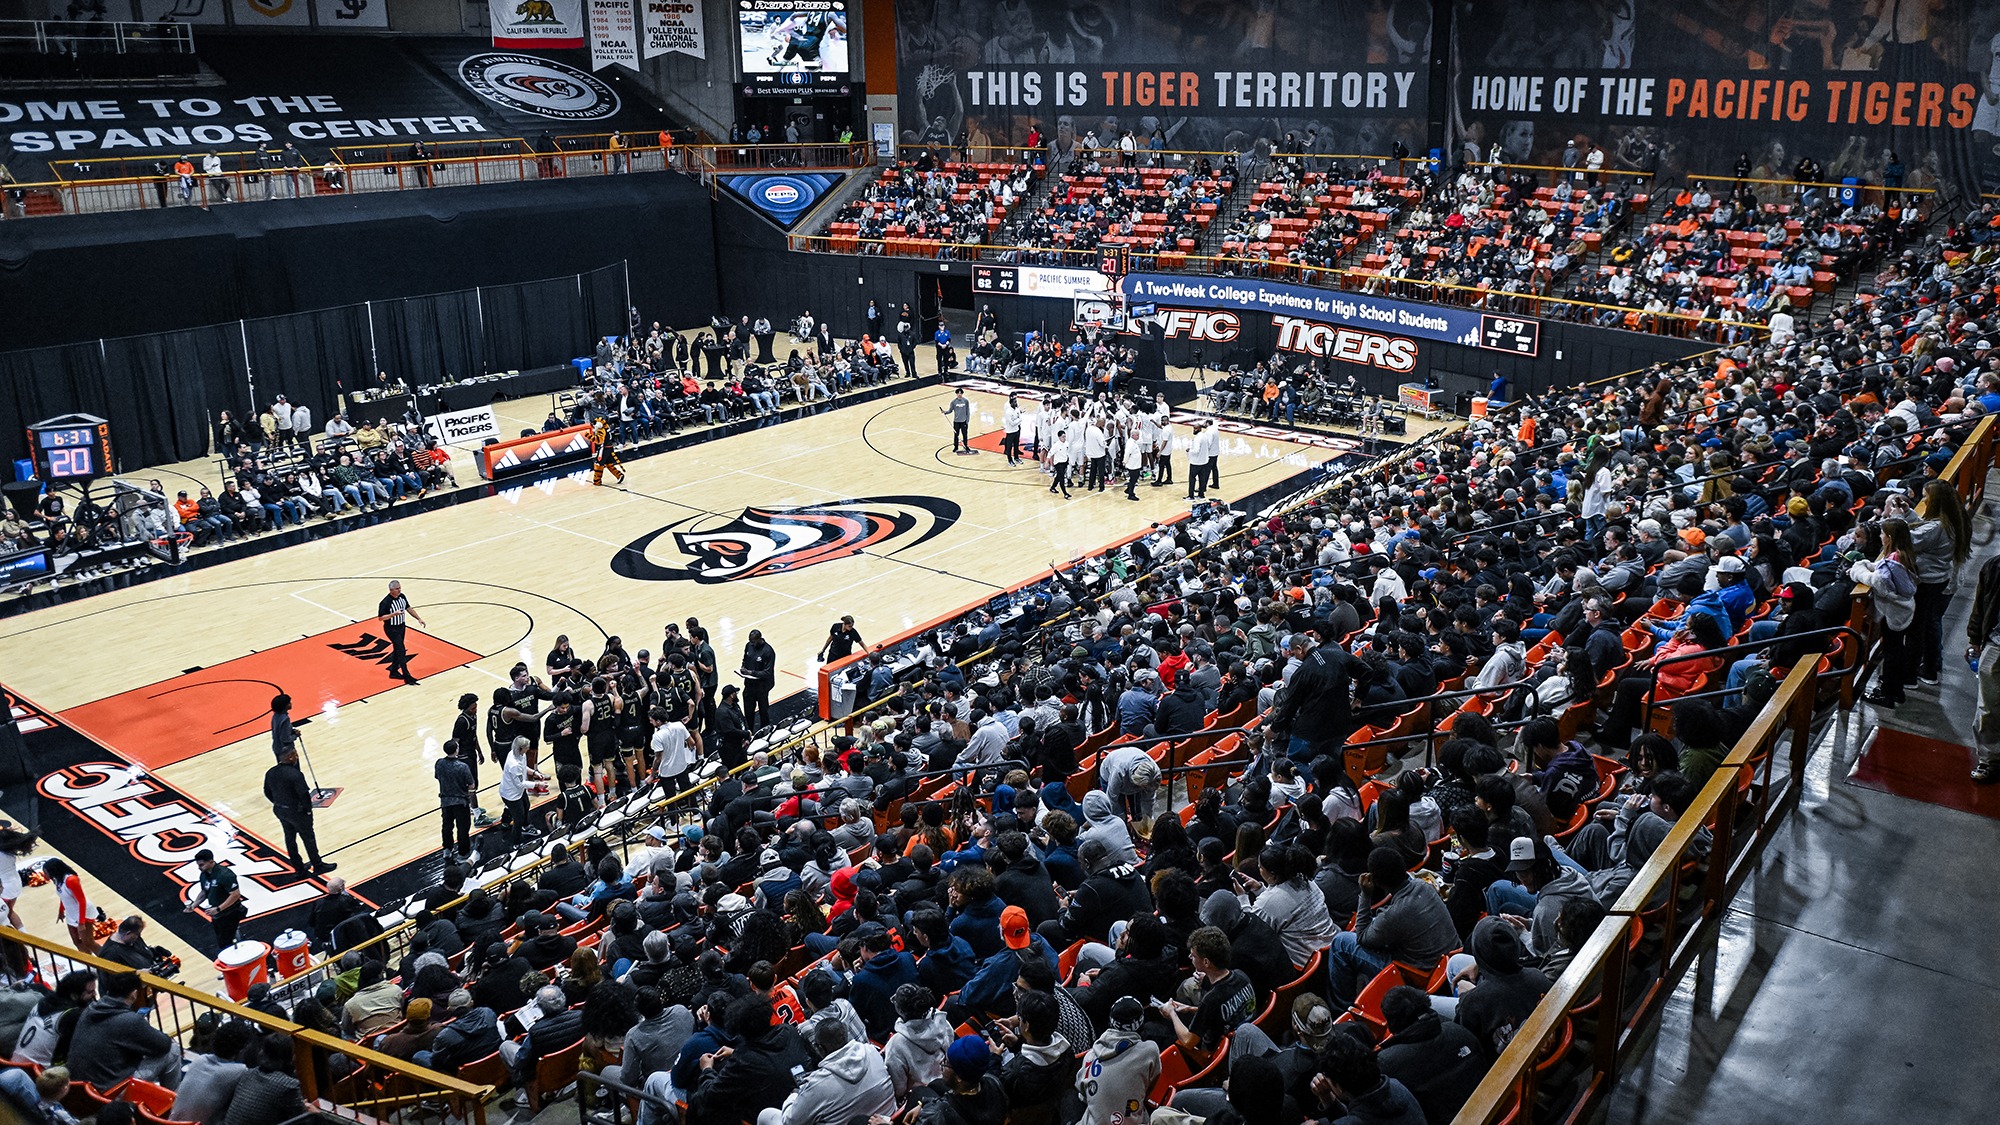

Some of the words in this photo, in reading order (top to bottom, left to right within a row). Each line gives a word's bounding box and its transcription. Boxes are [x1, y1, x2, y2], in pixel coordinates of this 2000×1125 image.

[594, 1, 629, 9] PACIFIC
[649, 4, 694, 13] PACIFIC
[795, 1, 831, 9] TIGERS
[647, 27, 698, 35] VOLLEYBALL
[653, 34, 694, 42] NATIONAL
[650, 41, 698, 49] CHAMPIONS
[479, 57, 541, 66] WINNING
[567, 70, 609, 95] FAMILY
[967, 71, 1042, 106] THIS
[1056, 71, 1088, 106] IS
[1102, 71, 1199, 107] TIGER
[1214, 71, 1416, 108] TERRITORY
[798, 87, 813, 95] PLUS
[138, 98, 222, 118] TO
[234, 95, 343, 117] THE
[536, 102, 611, 118] INNOVATION
[1471, 76, 1543, 112] HOME
[1553, 76, 1587, 114] OF
[1600, 78, 1655, 116] THE
[1665, 78, 1809, 122] PACIFIC
[1827, 80, 1976, 129] TIGERS
[9, 124, 274, 152] SPANOS
[288, 115, 487, 140] CENTER
[1101, 258, 1117, 273] 20
[977, 278, 992, 289] 62
[1000, 280, 1013, 290] 47
[1039, 274, 1063, 284] PACIFIC
[1064, 275, 1091, 286] SUMMER
[1134, 281, 1143, 294] A
[1146, 281, 1206, 298] Two-Week
[1209, 285, 1256, 304] College
[1259, 289, 1313, 309] Experience
[1314, 297, 1329, 312] for
[1332, 300, 1357, 320] High
[1359, 304, 1396, 323] School
[1398, 312, 1448, 332] Students
[1494, 319, 1524, 334] 6:37
[1272, 313, 1418, 373] TIGERS
[445, 412, 491, 428] PACIFIC
[54, 429, 91, 446] 6:37
[447, 422, 493, 438] TIGERS
[52, 448, 90, 476] 20
[597, 705, 611, 720] 32
[628, 703, 637, 717] 4
[665, 698, 674, 712] 5
[578, 798, 585, 812] 1
[292, 952, 306, 967] G
[20, 1025, 37, 1048] 0
[1084, 1058, 1102, 1079] 76
